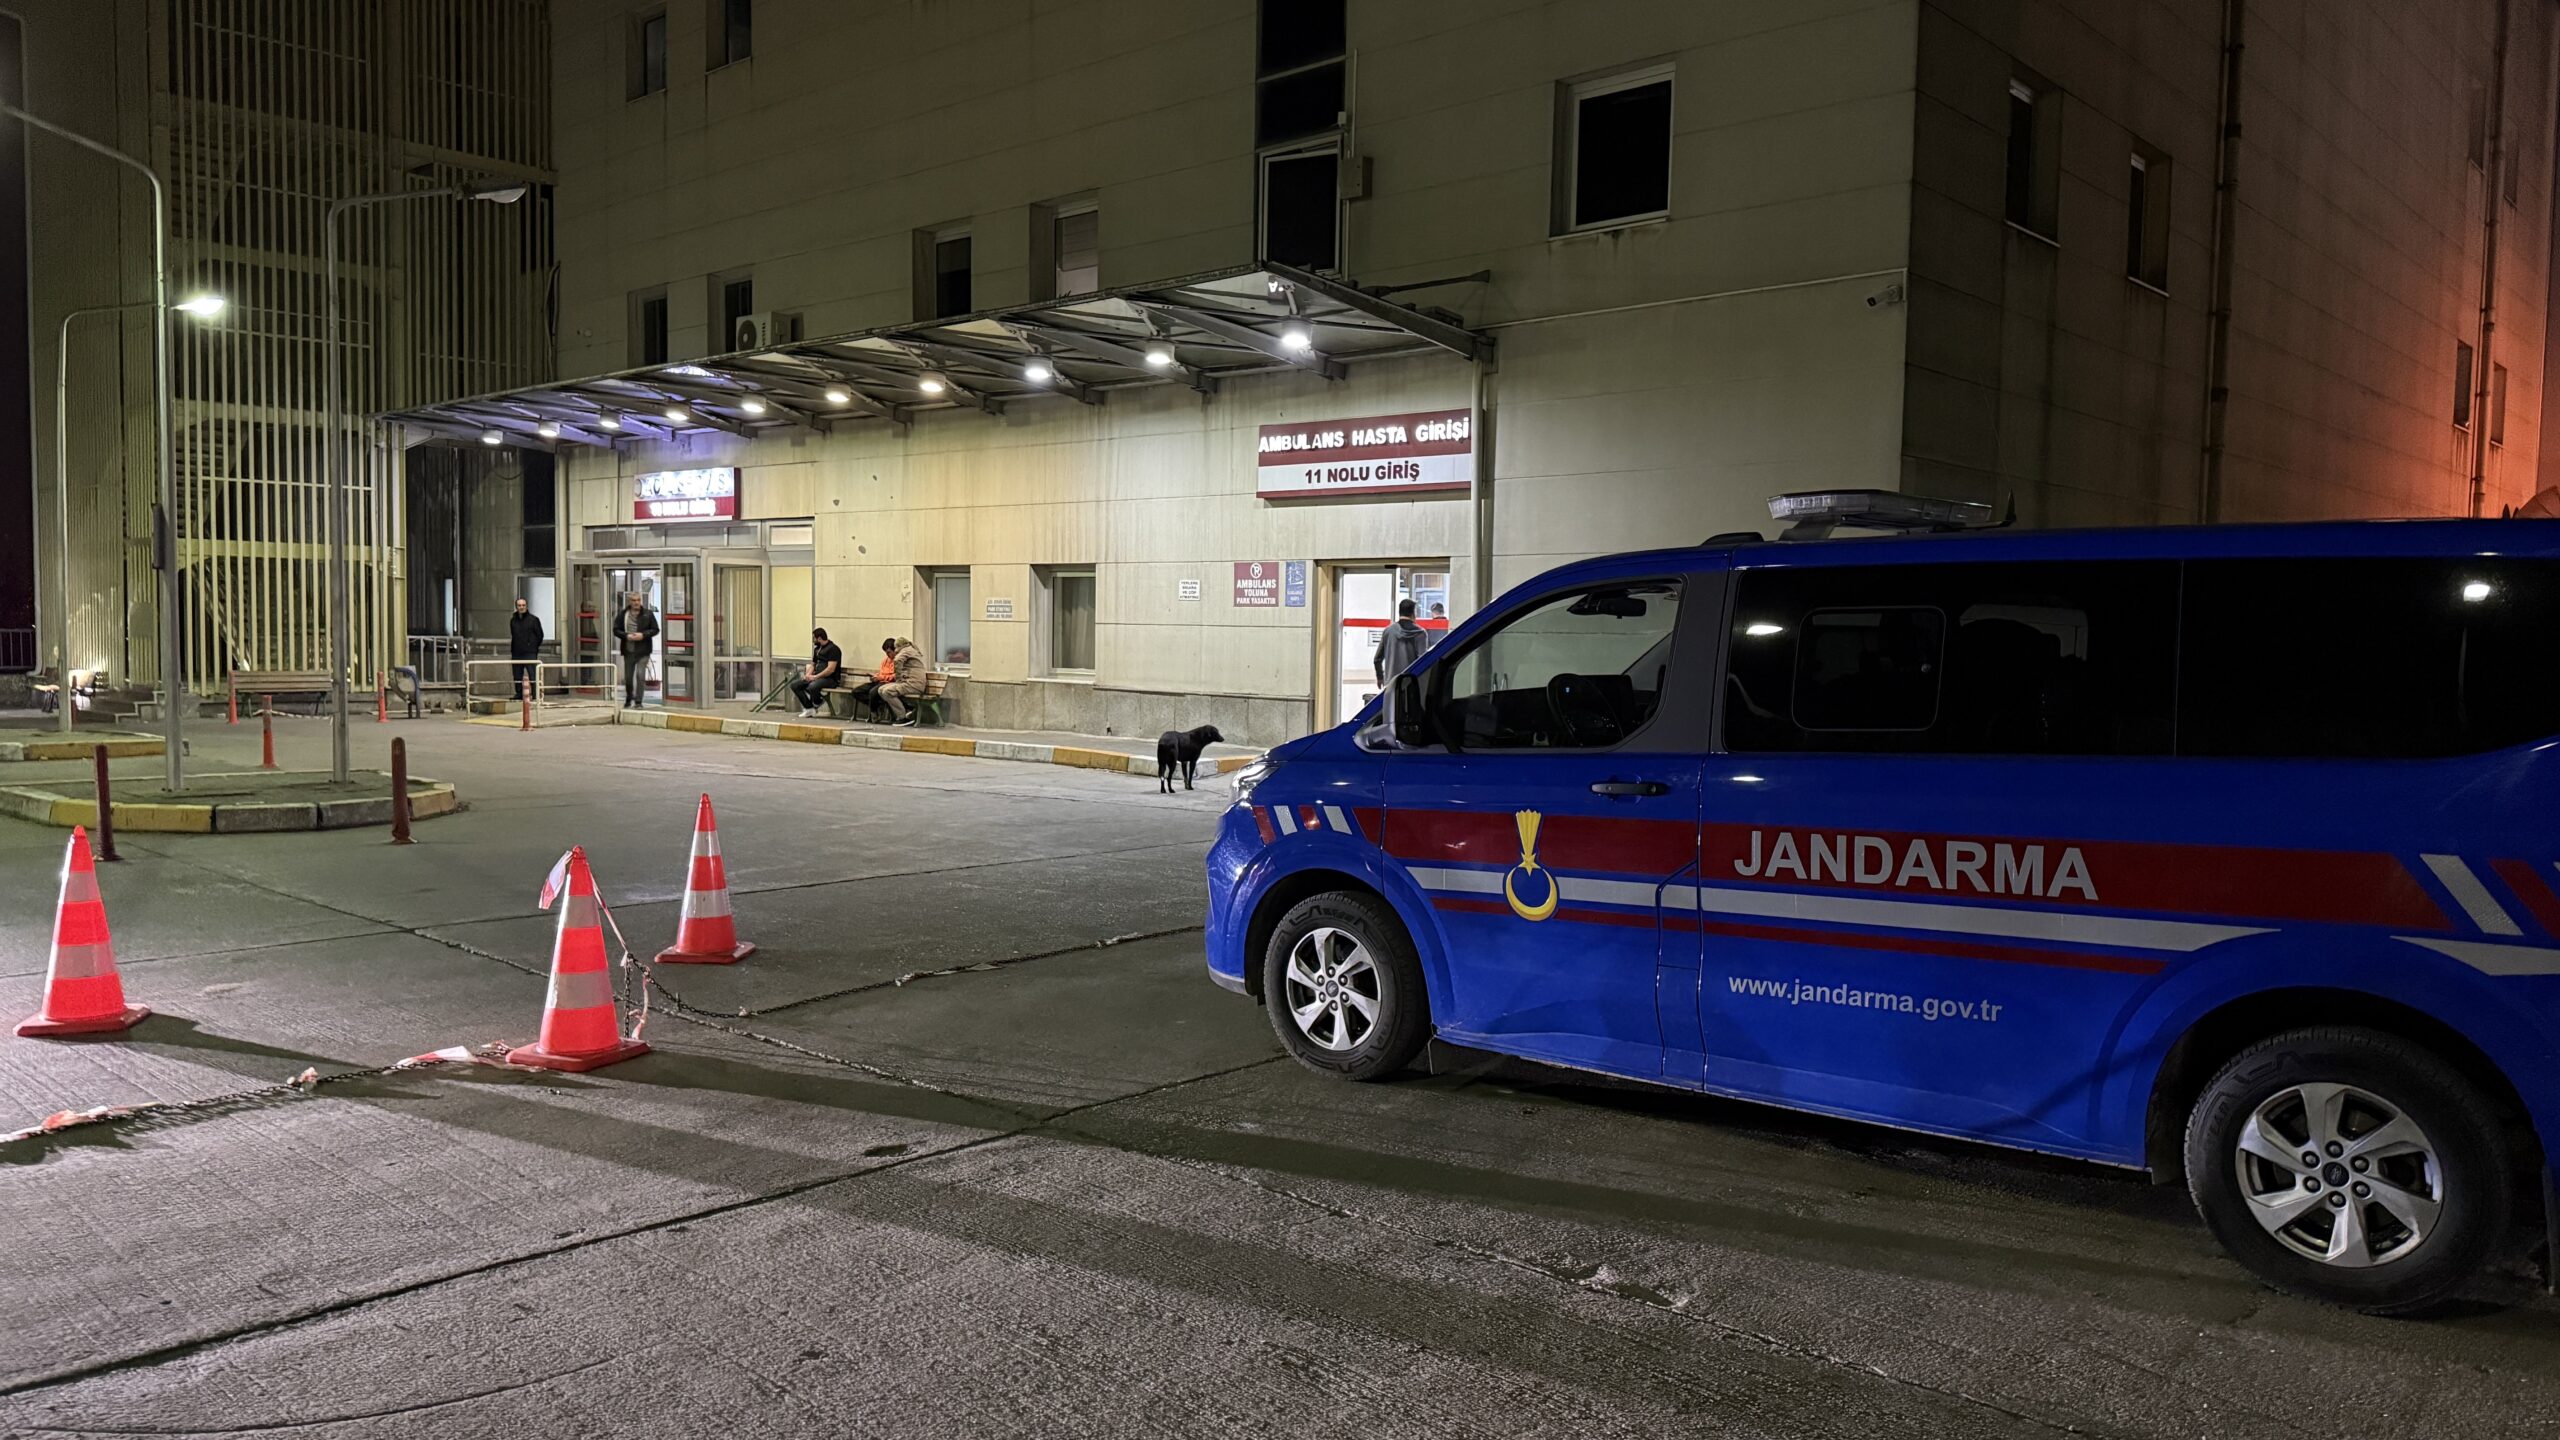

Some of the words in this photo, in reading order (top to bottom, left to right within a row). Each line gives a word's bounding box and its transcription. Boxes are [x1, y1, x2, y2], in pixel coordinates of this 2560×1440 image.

[1259, 431, 1344, 453] AMBULANS
[1351, 426, 1407, 446] HASTA
[1415, 417, 1469, 442] GİRİŞİ
[1305, 469, 1321, 484] 11
[1327, 467, 1370, 482] NOLU
[1375, 461, 1420, 482] GİRİŞ
[1237, 579, 1277, 589] AMBULANS
[1244, 589, 1268, 597] YOLUNA
[1734, 830, 2099, 901] JANDARMA
[1728, 974, 2003, 1022] www.jandarma.gov.tr
